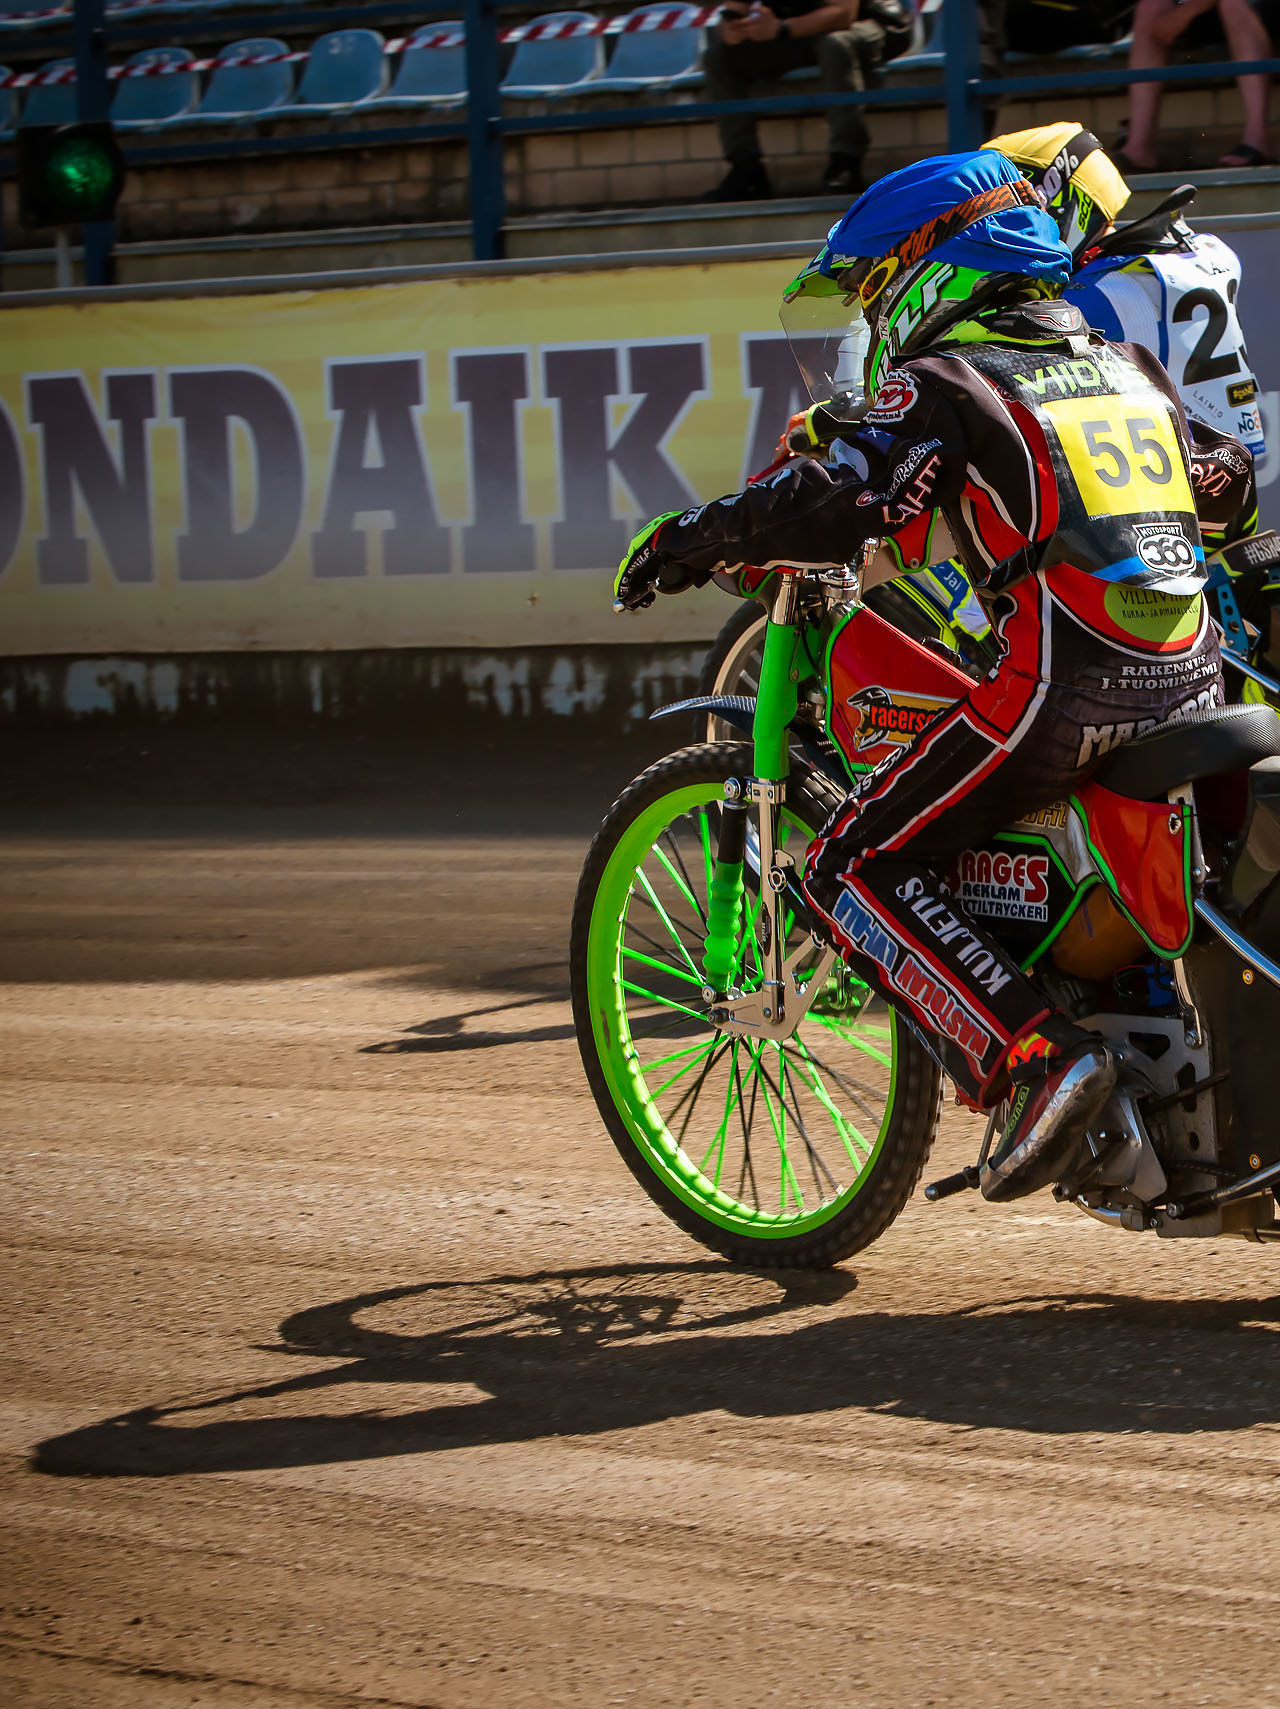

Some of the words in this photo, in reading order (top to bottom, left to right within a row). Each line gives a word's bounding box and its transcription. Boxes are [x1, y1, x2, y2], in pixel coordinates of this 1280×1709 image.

[1081, 417, 1172, 488] 55
[1140, 526, 1180, 537] MOTOSPORT
[1142, 537, 1192, 567] 360
[1121, 653, 1206, 677] RAKENNUS
[962, 883, 1021, 901] REKLAM
[961, 899, 1048, 922] TILTRYCKERI
[895, 953, 991, 1061] NASTOLAN
